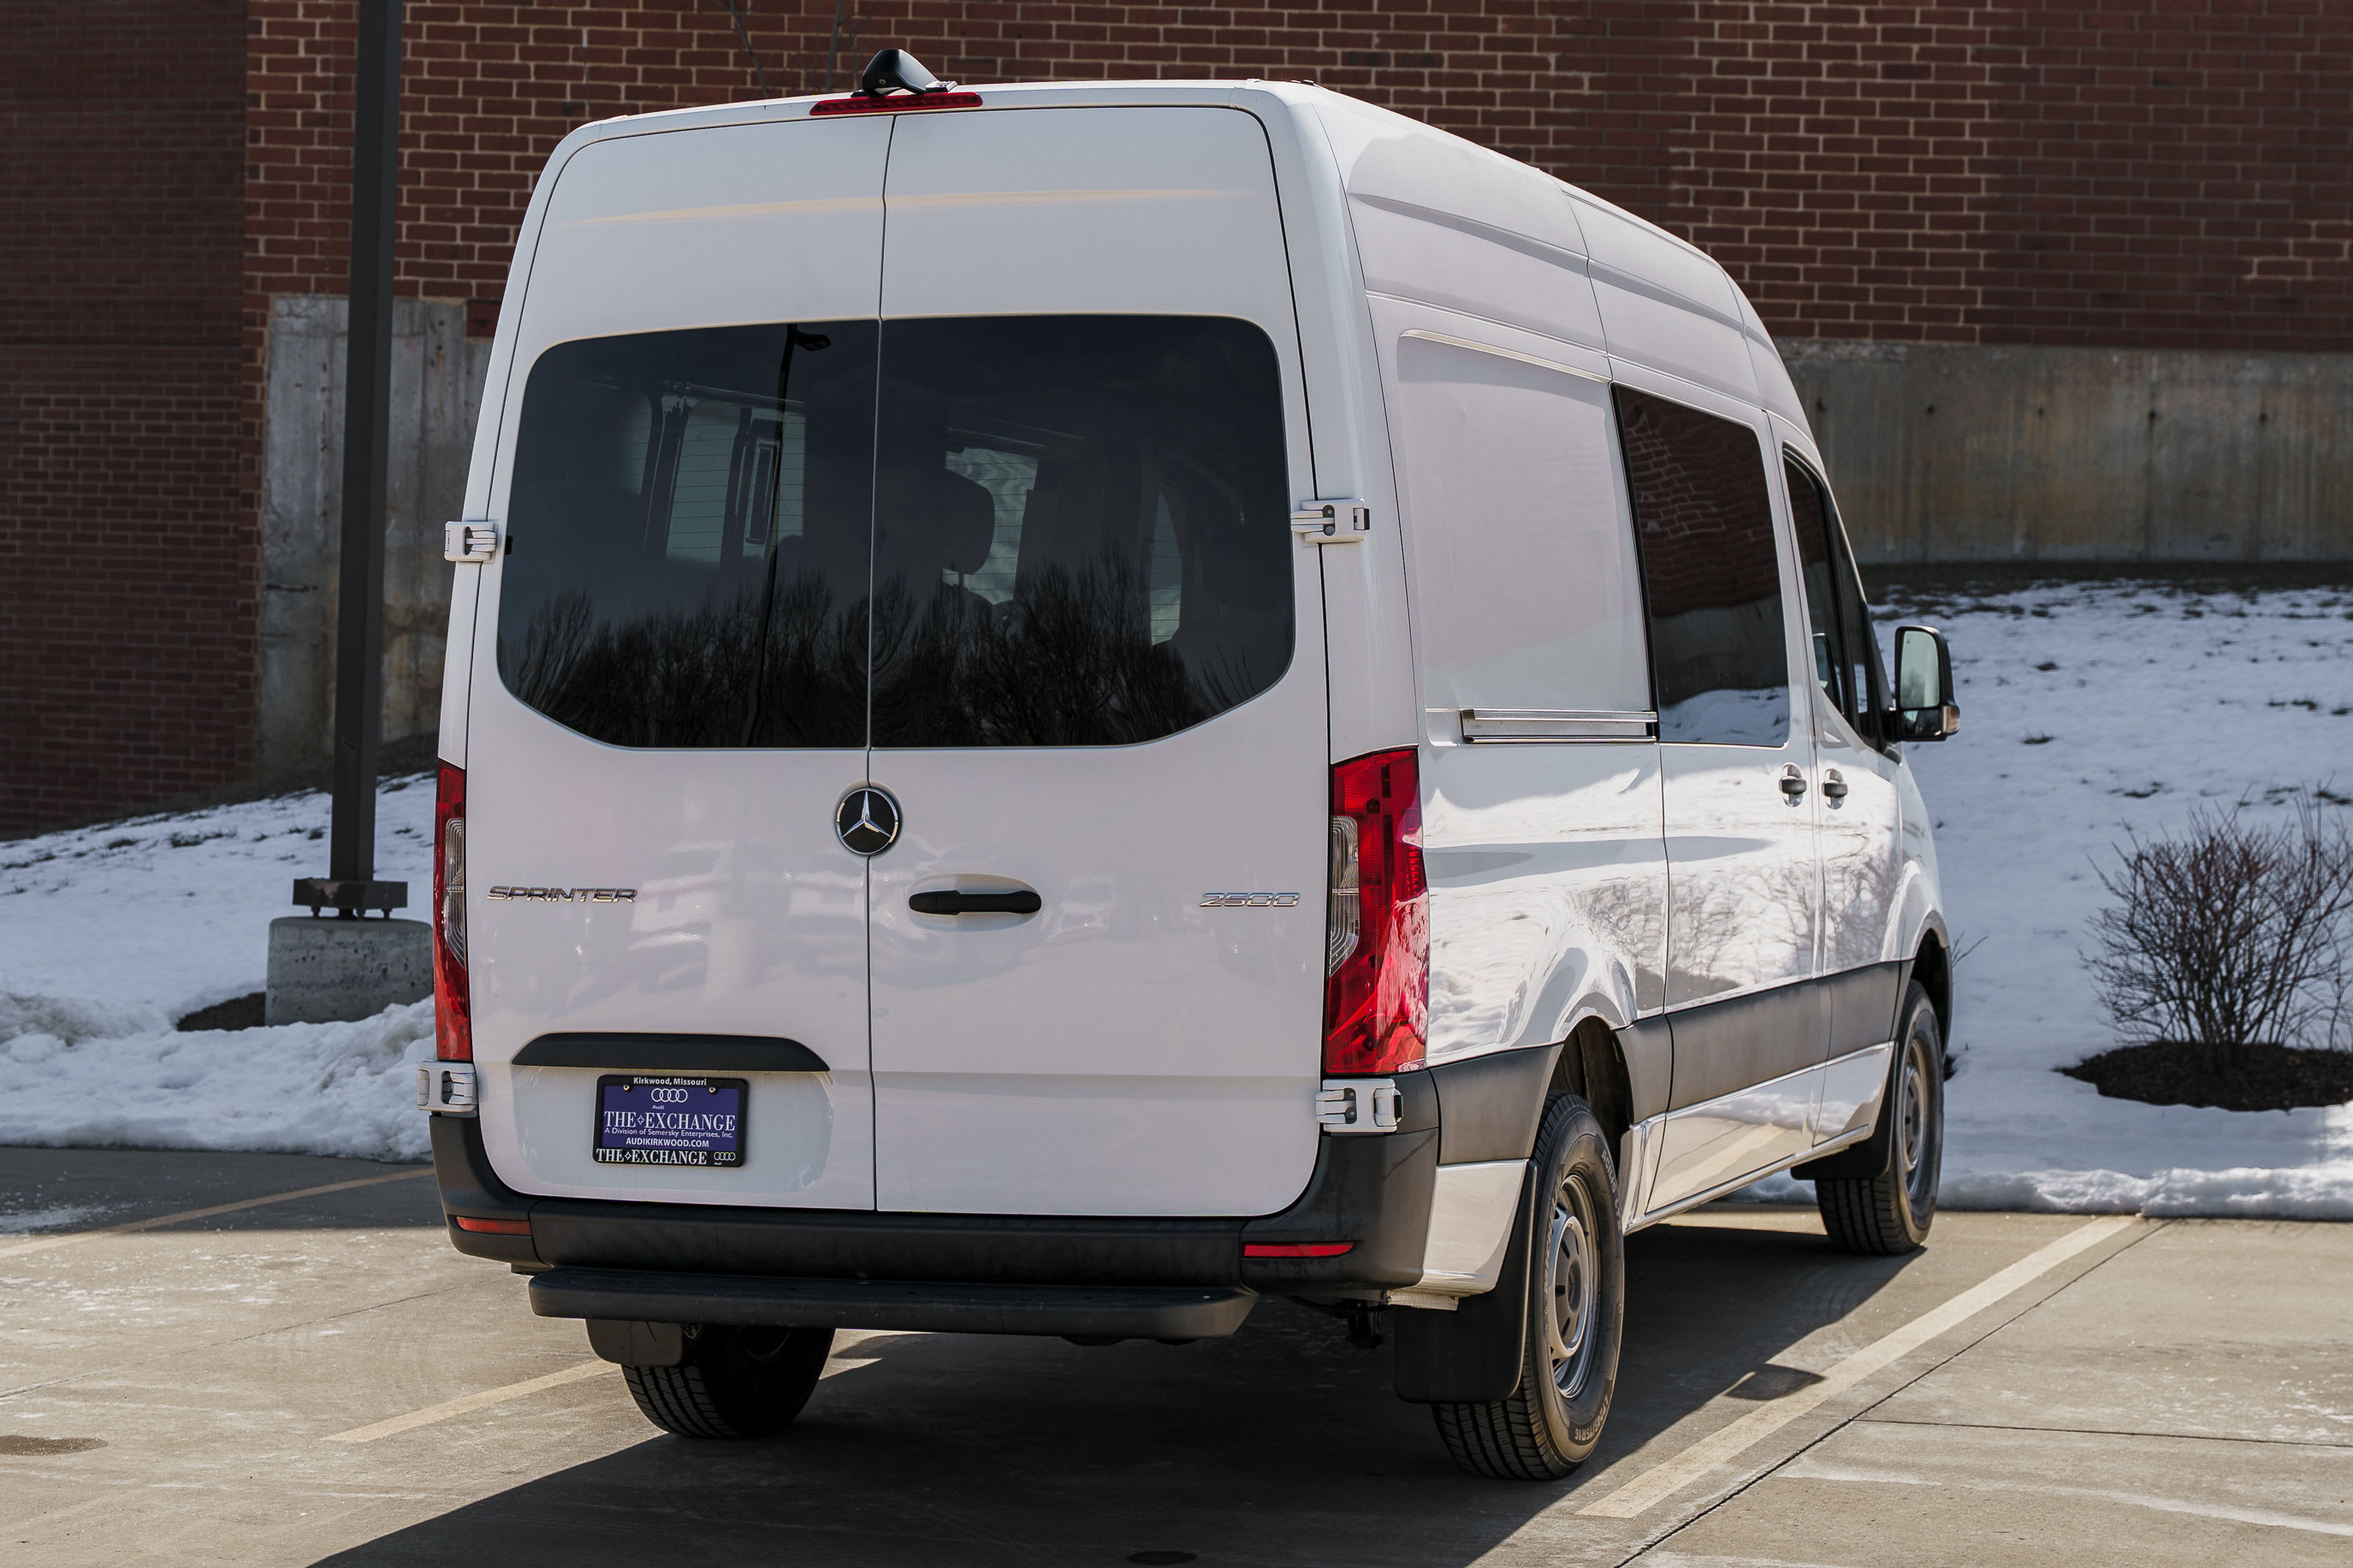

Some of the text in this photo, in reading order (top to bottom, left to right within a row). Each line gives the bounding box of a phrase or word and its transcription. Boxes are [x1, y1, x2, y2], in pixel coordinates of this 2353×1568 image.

[486, 885, 637, 903] SPRINTER
[1199, 892, 1301, 908] 2500
[633, 1077, 672, 1086] Kirkwood,
[604, 1110, 735, 1131] THE EXCHANGE
[648, 1129, 679, 1138] Semersky
[681, 1130, 720, 1139] Enterprises,
[625, 1138, 709, 1148] AUDIKIRKWOOD.COM
[596, 1148, 707, 1165] THE EXCHANGE
